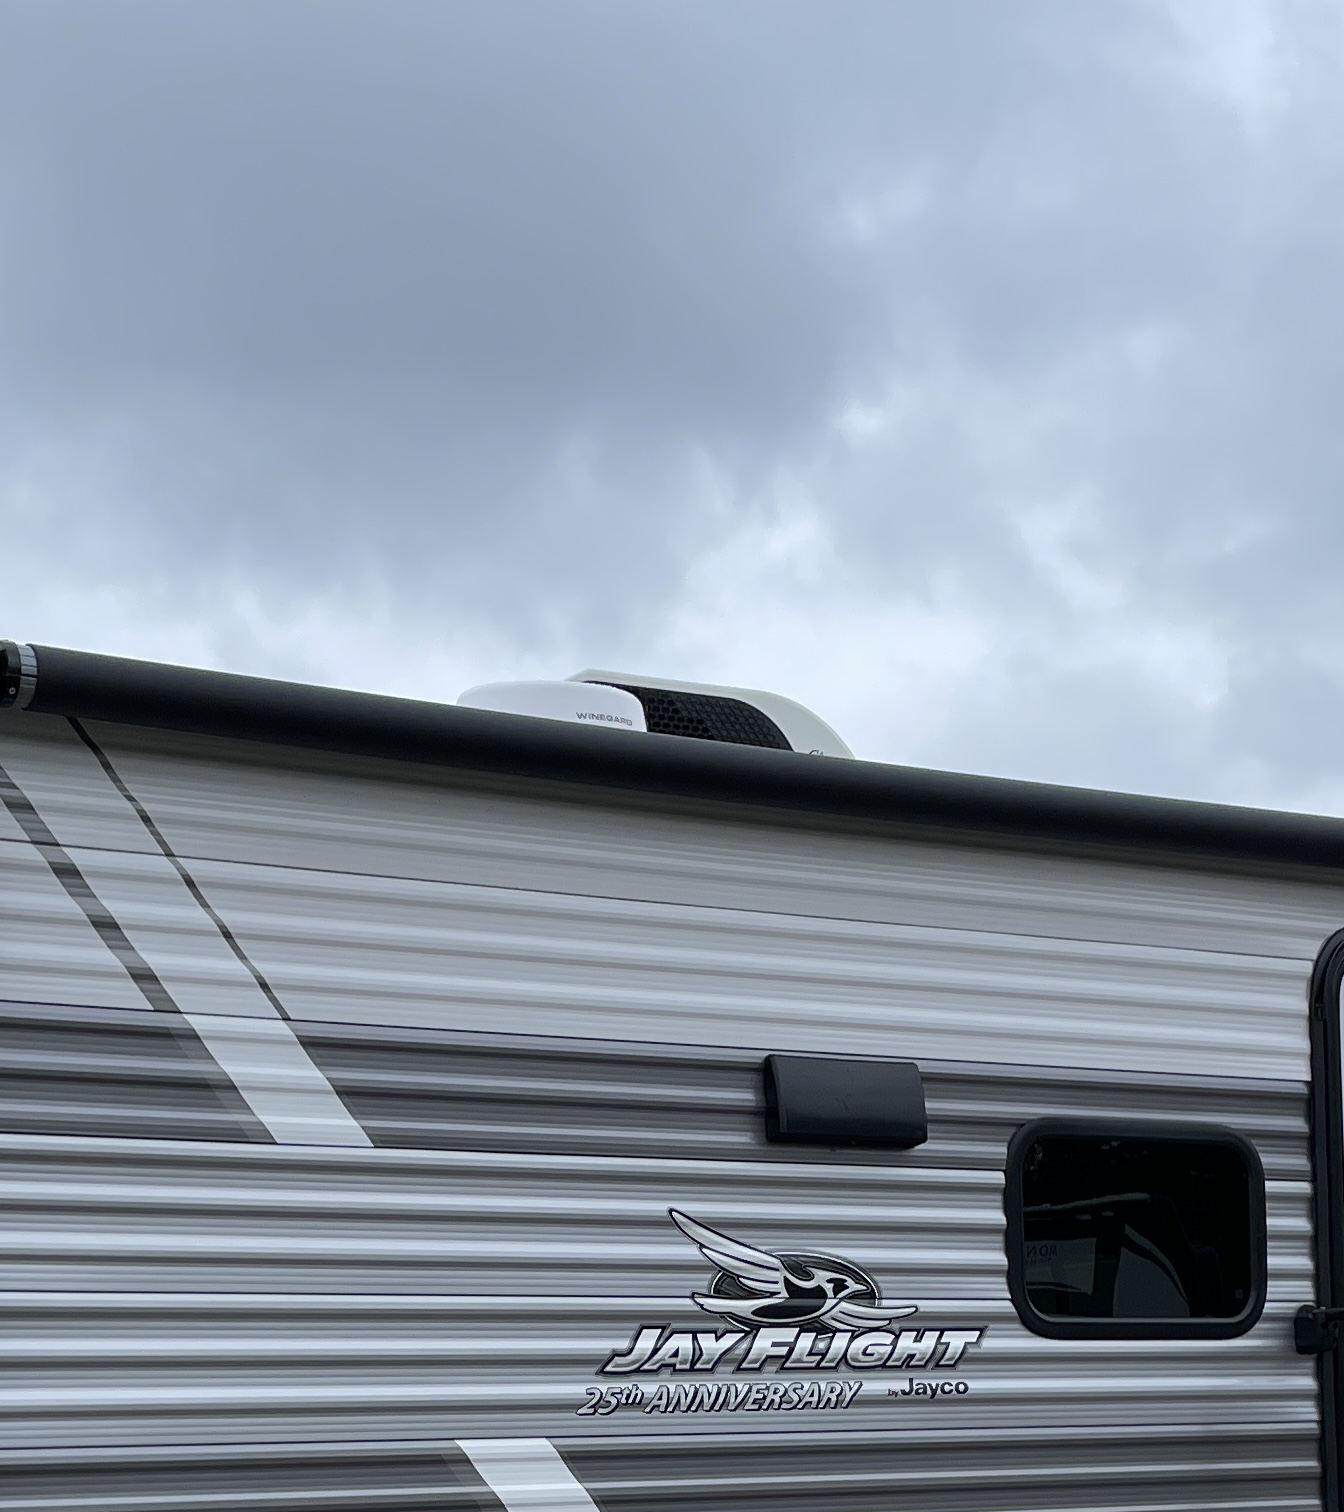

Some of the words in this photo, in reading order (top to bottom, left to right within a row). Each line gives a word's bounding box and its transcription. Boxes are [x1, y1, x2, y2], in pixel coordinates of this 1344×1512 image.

[576, 711, 632, 726] WINEGARD
[597, 1324, 754, 1375] JAY
[736, 1326, 985, 1371] FLIGHT
[576, 1384, 644, 1415] 25th
[643, 1381, 862, 1414] ANNIVERSARY
[887, 1389, 899, 1398] by
[900, 1378, 969, 1399] Jayco
